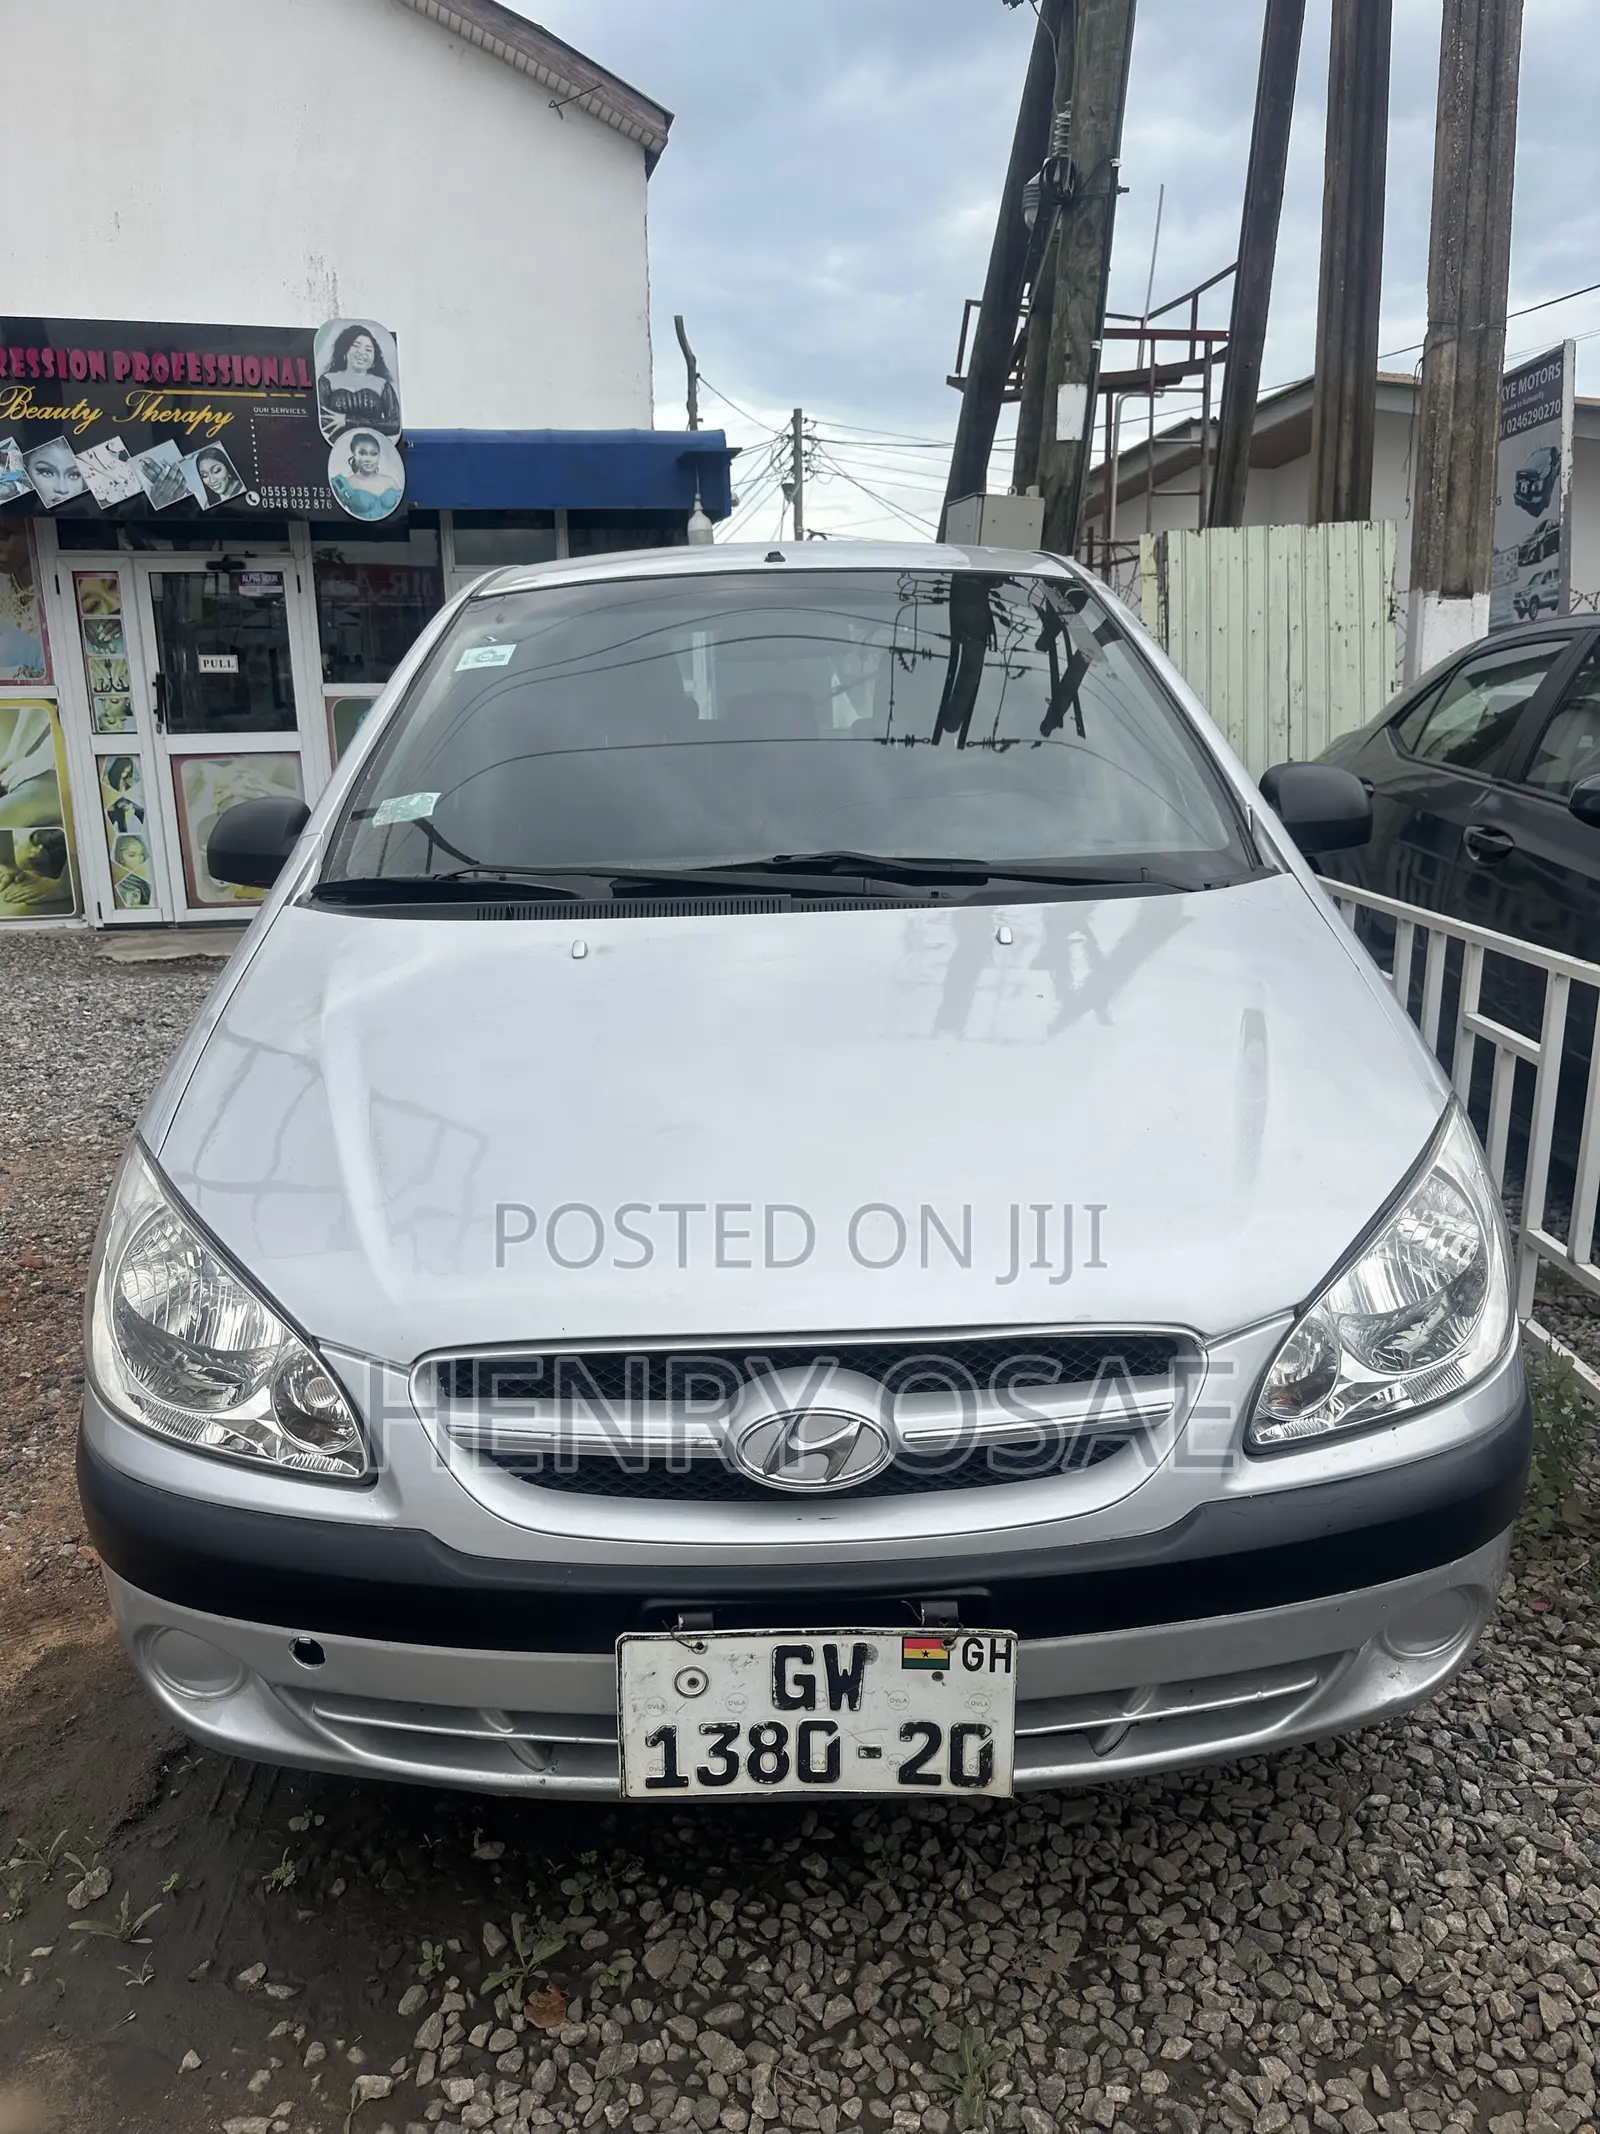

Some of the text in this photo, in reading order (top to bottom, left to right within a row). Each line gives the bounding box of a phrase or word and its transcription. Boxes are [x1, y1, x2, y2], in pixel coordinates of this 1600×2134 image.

[113, 351, 313, 389] PROFESSIONAL
[1518, 361, 1561, 395] MOTORS
[0, 386, 235, 438] Beauty Therapy
[253, 406, 269, 414] OUR
[1507, 399, 1561, 433] 0246290270
[260, 486, 332, 498] 0555 935 753
[262, 498, 333, 510] 0548 032 876
[203, 659, 234, 668] PULL
[962, 1637, 1011, 1673] GH
[771, 1643, 868, 1711] GW
